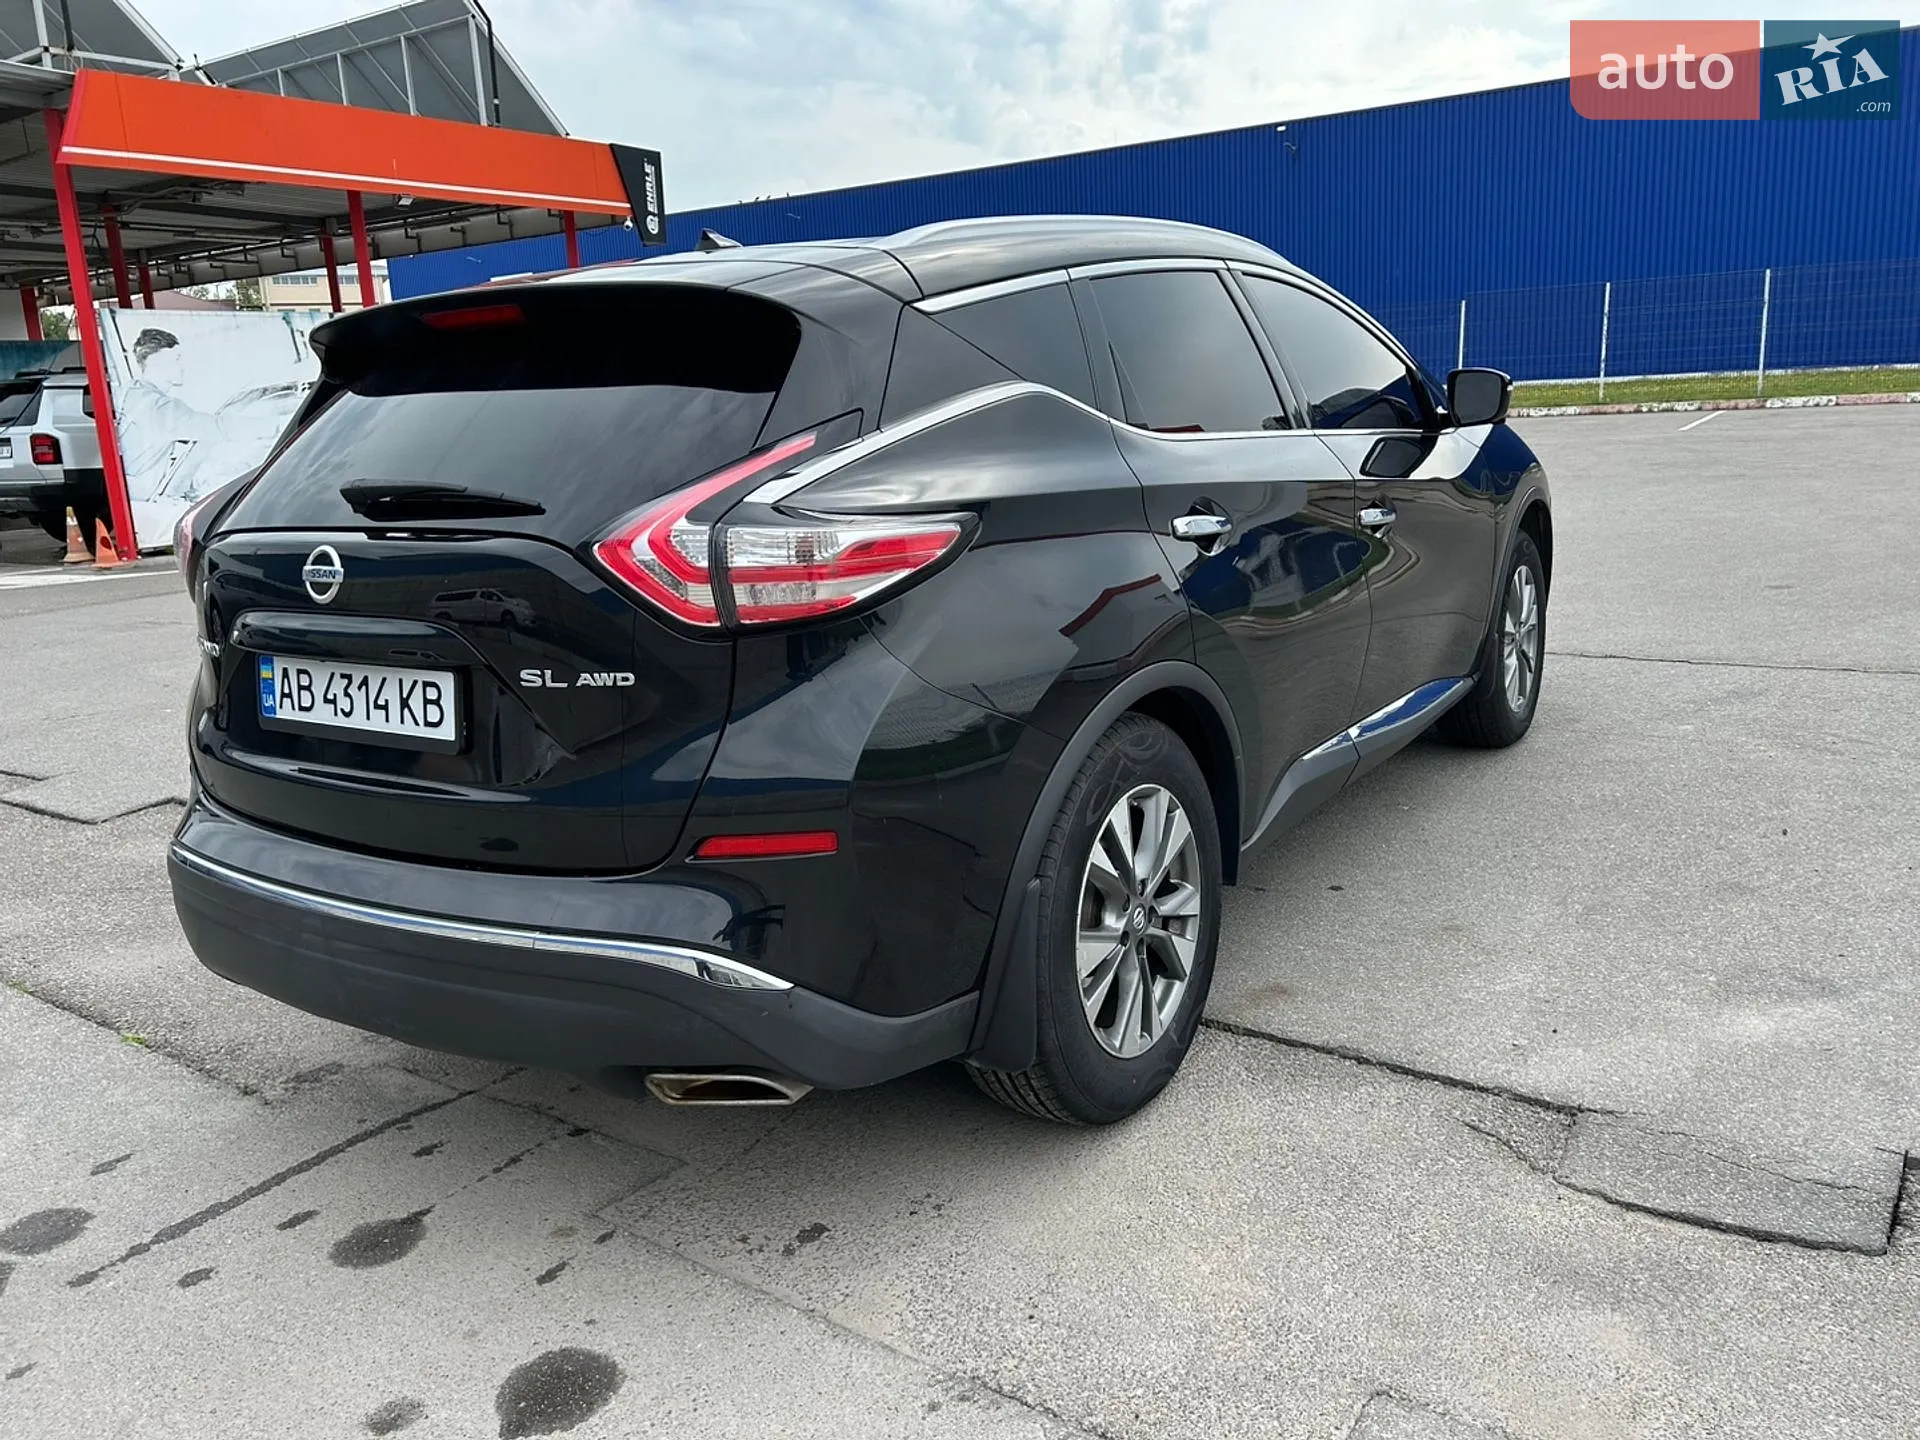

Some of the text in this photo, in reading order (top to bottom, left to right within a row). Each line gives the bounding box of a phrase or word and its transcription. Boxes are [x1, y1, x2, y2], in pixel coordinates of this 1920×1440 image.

[644, 162, 657, 213] EHRLE
[520, 669, 635, 688] SL AWD
[264, 692, 275, 708] UA
[279, 667, 445, 728] AB 4314 KB
